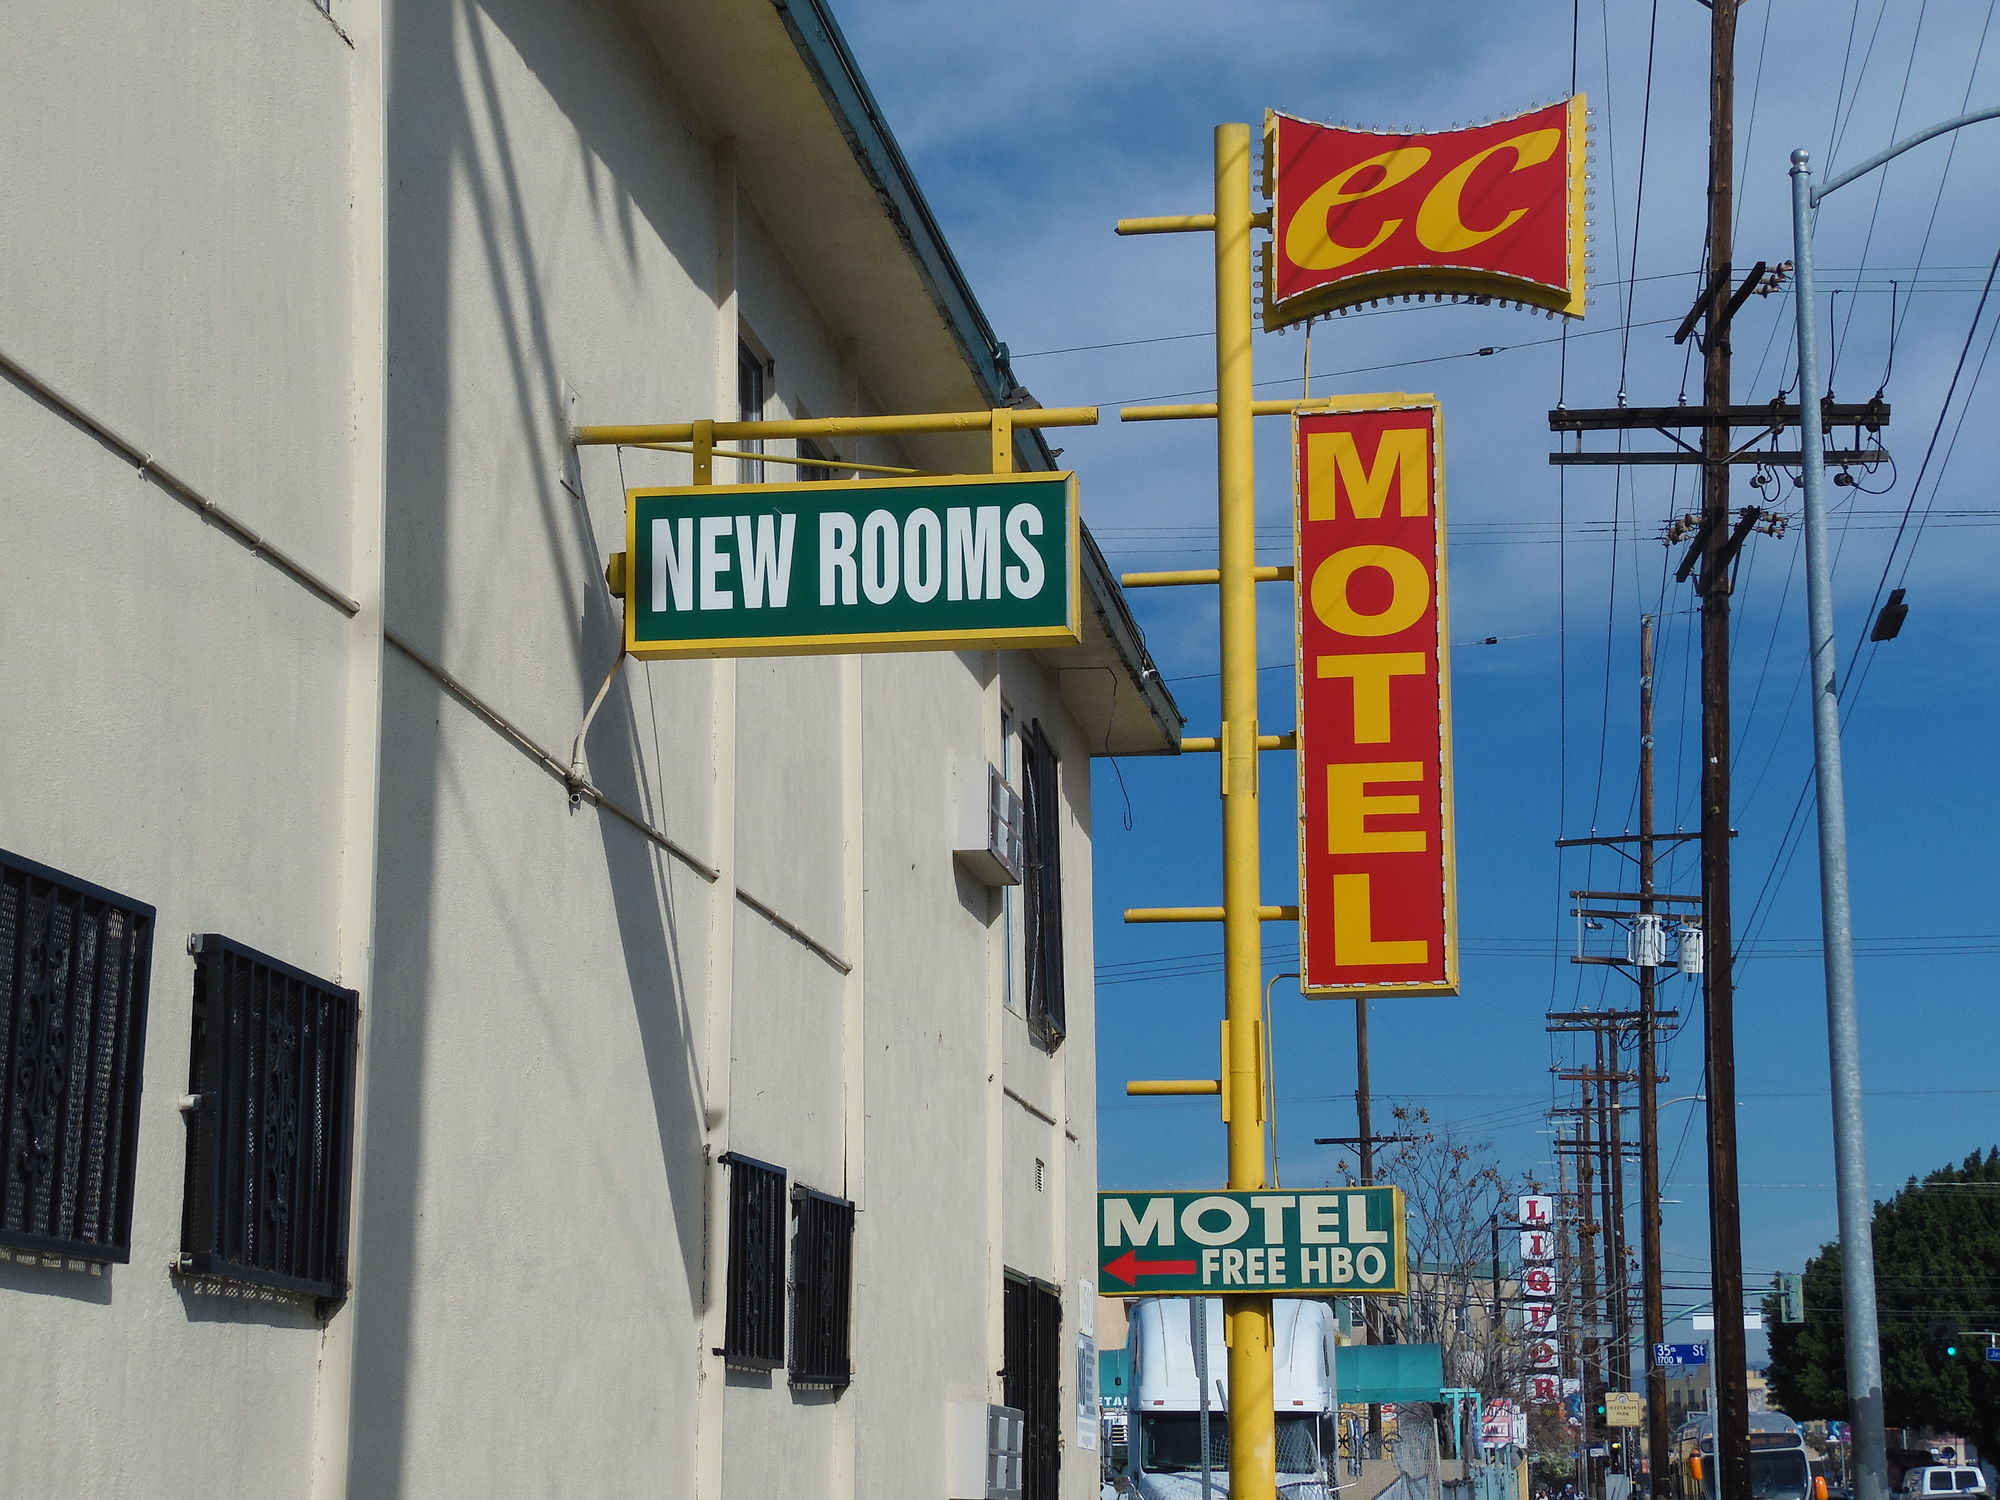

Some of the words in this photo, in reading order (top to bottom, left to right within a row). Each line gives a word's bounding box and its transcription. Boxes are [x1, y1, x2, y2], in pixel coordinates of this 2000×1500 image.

[651, 513, 797, 612] NEW
[819, 502, 1046, 606] ROOMS
[1306, 427, 1431, 967] MOTEL
[1103, 1194, 1388, 1247] MOTEL
[1202, 1247, 1287, 1285] FREE
[1300, 1245, 1387, 1284] HBO
[1525, 1200, 1557, 1400] LIQUOR
[1657, 1356, 1674, 1364] 1700
[1676, 1356, 1683, 1364] W
[1692, 1344, 1704, 1356] St
